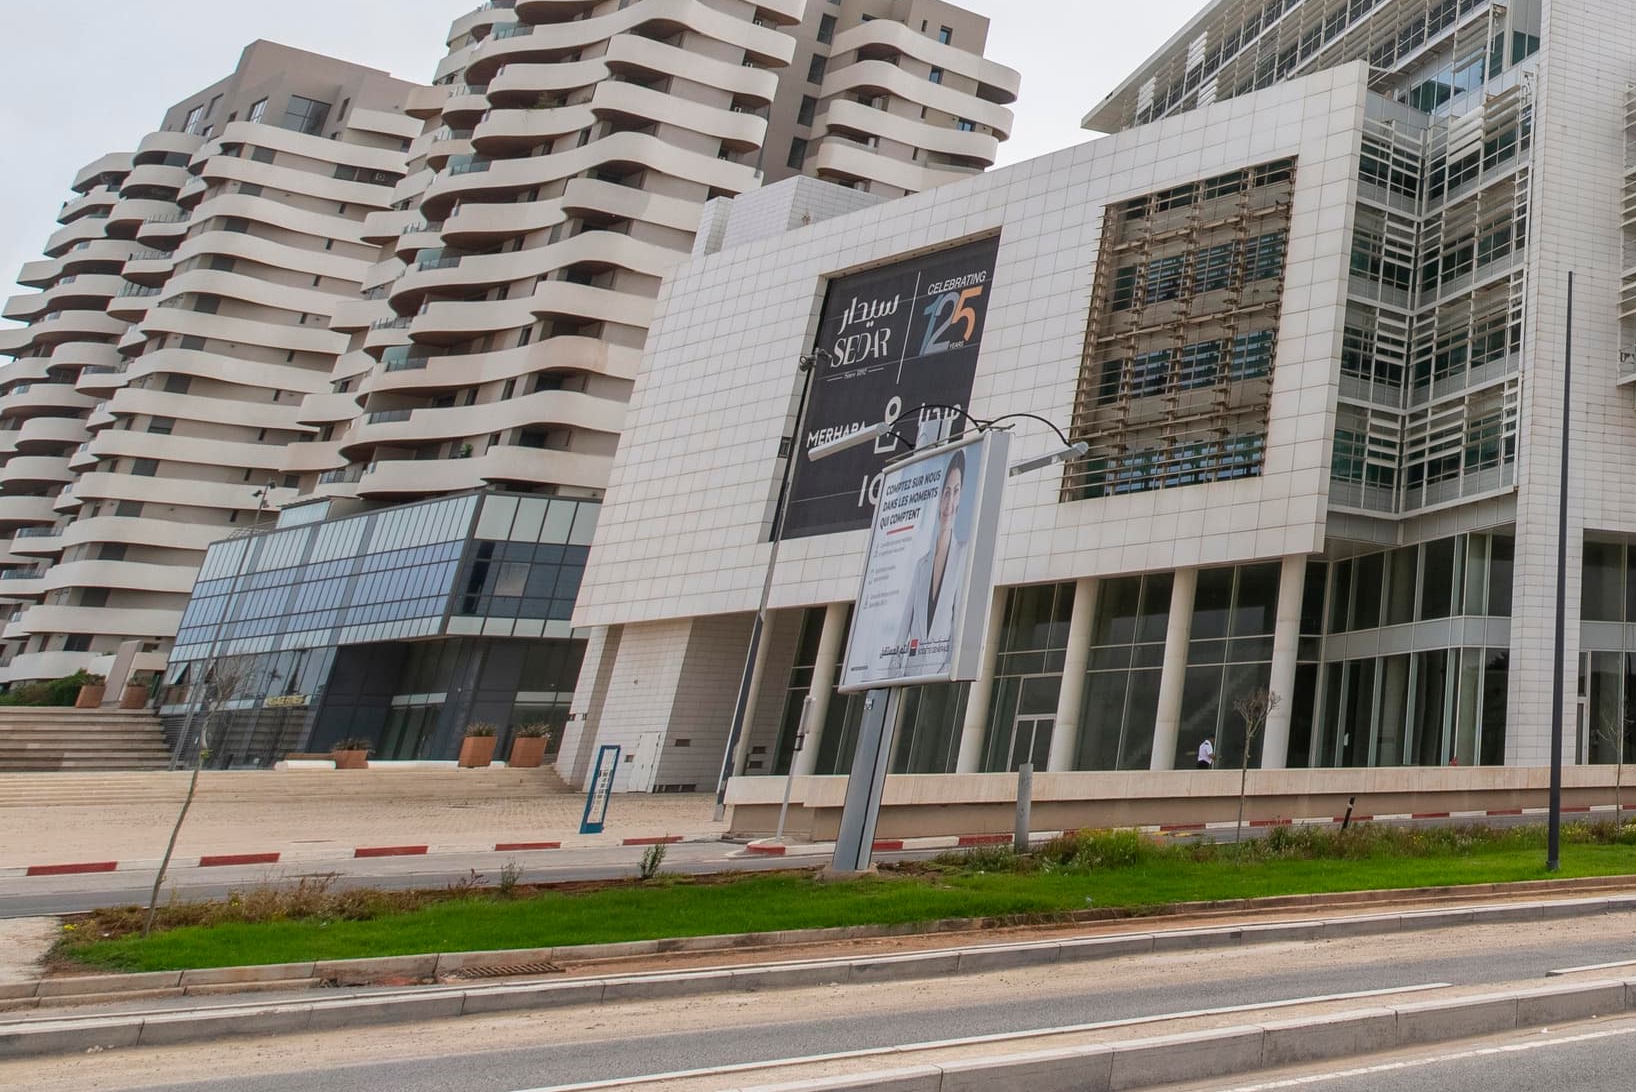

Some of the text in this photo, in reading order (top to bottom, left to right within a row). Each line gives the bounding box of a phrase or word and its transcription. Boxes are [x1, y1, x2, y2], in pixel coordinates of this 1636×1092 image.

[927, 270, 987, 296] CELEBRATING
[837, 293, 900, 336] سيدار
[918, 285, 983, 357] 125
[831, 328, 891, 368] SEDAR
[886, 470, 942, 496] COMPTEZ SUR NOUS
[883, 486, 939, 512] DANS LES MOMENTS
[880, 508, 921, 530] QUI COMPTENT
